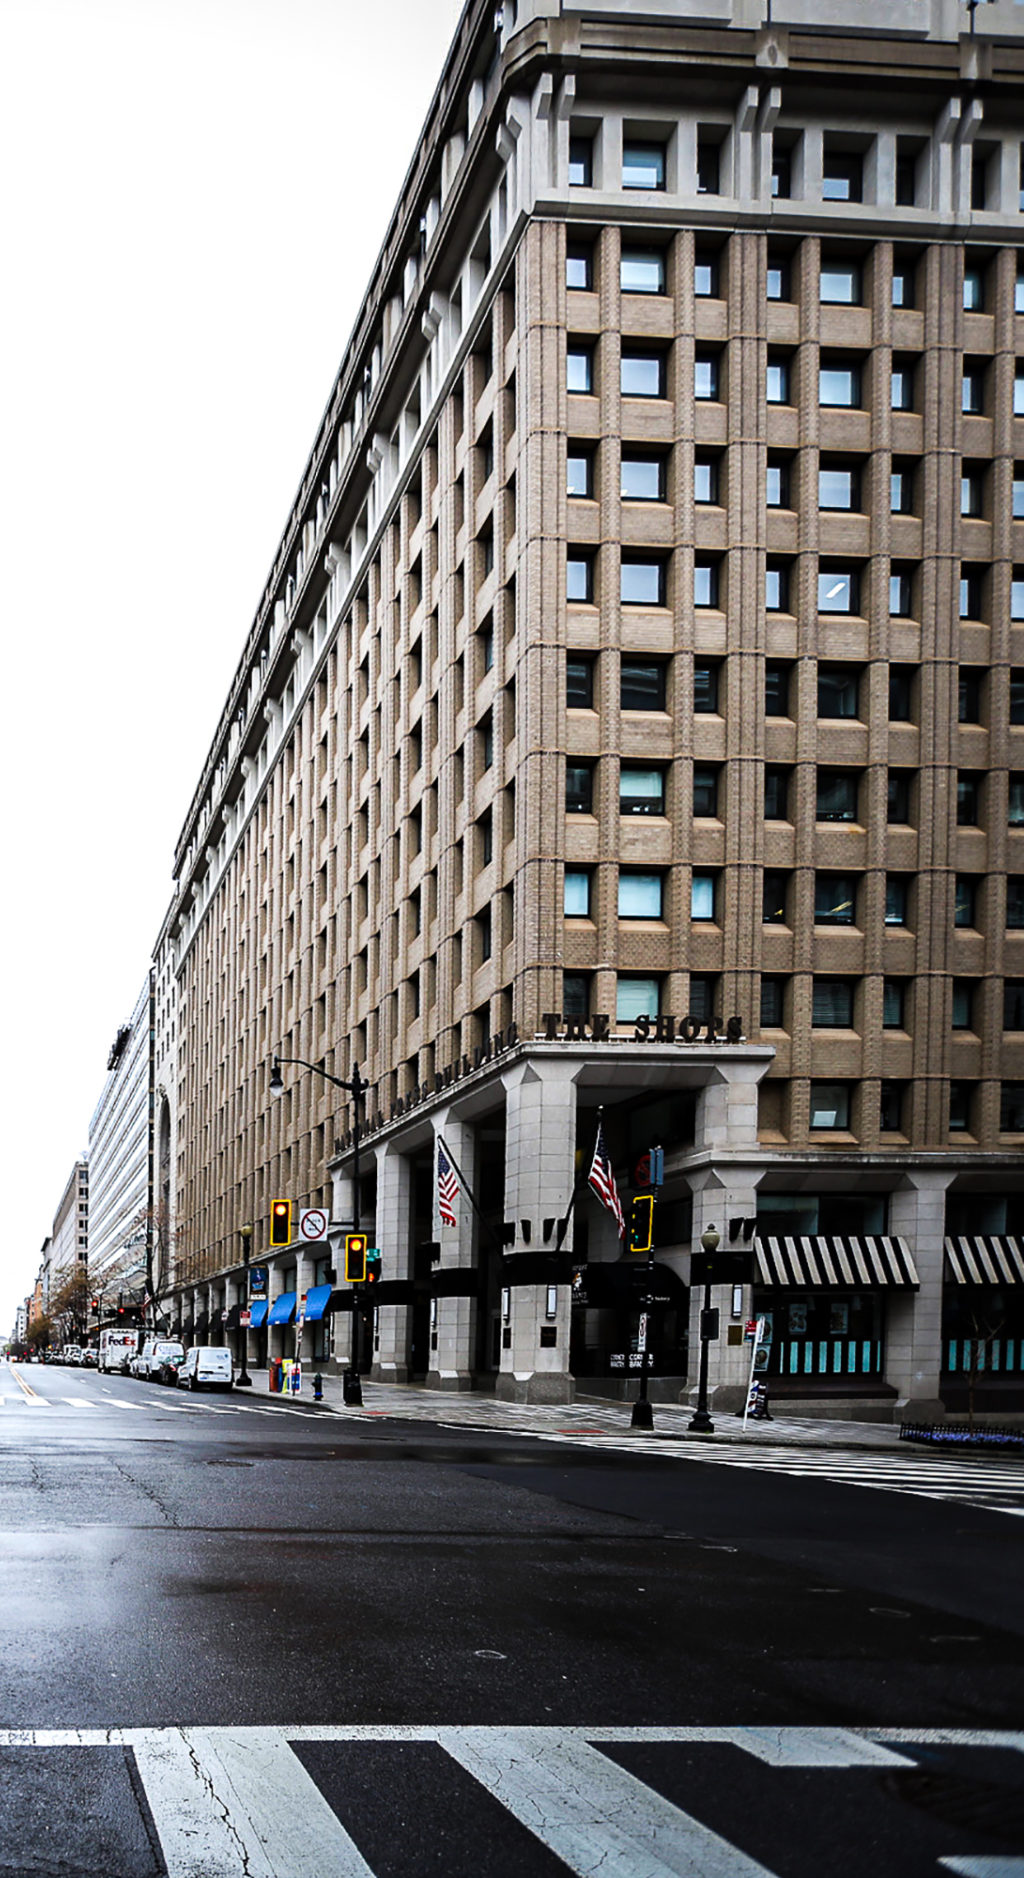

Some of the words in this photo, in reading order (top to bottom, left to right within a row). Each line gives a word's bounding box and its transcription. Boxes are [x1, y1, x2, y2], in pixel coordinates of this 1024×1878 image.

[542, 1013, 610, 1041] THE
[635, 1014, 742, 1043] SHOPS
[108, 1335, 136, 1346] FedEx
